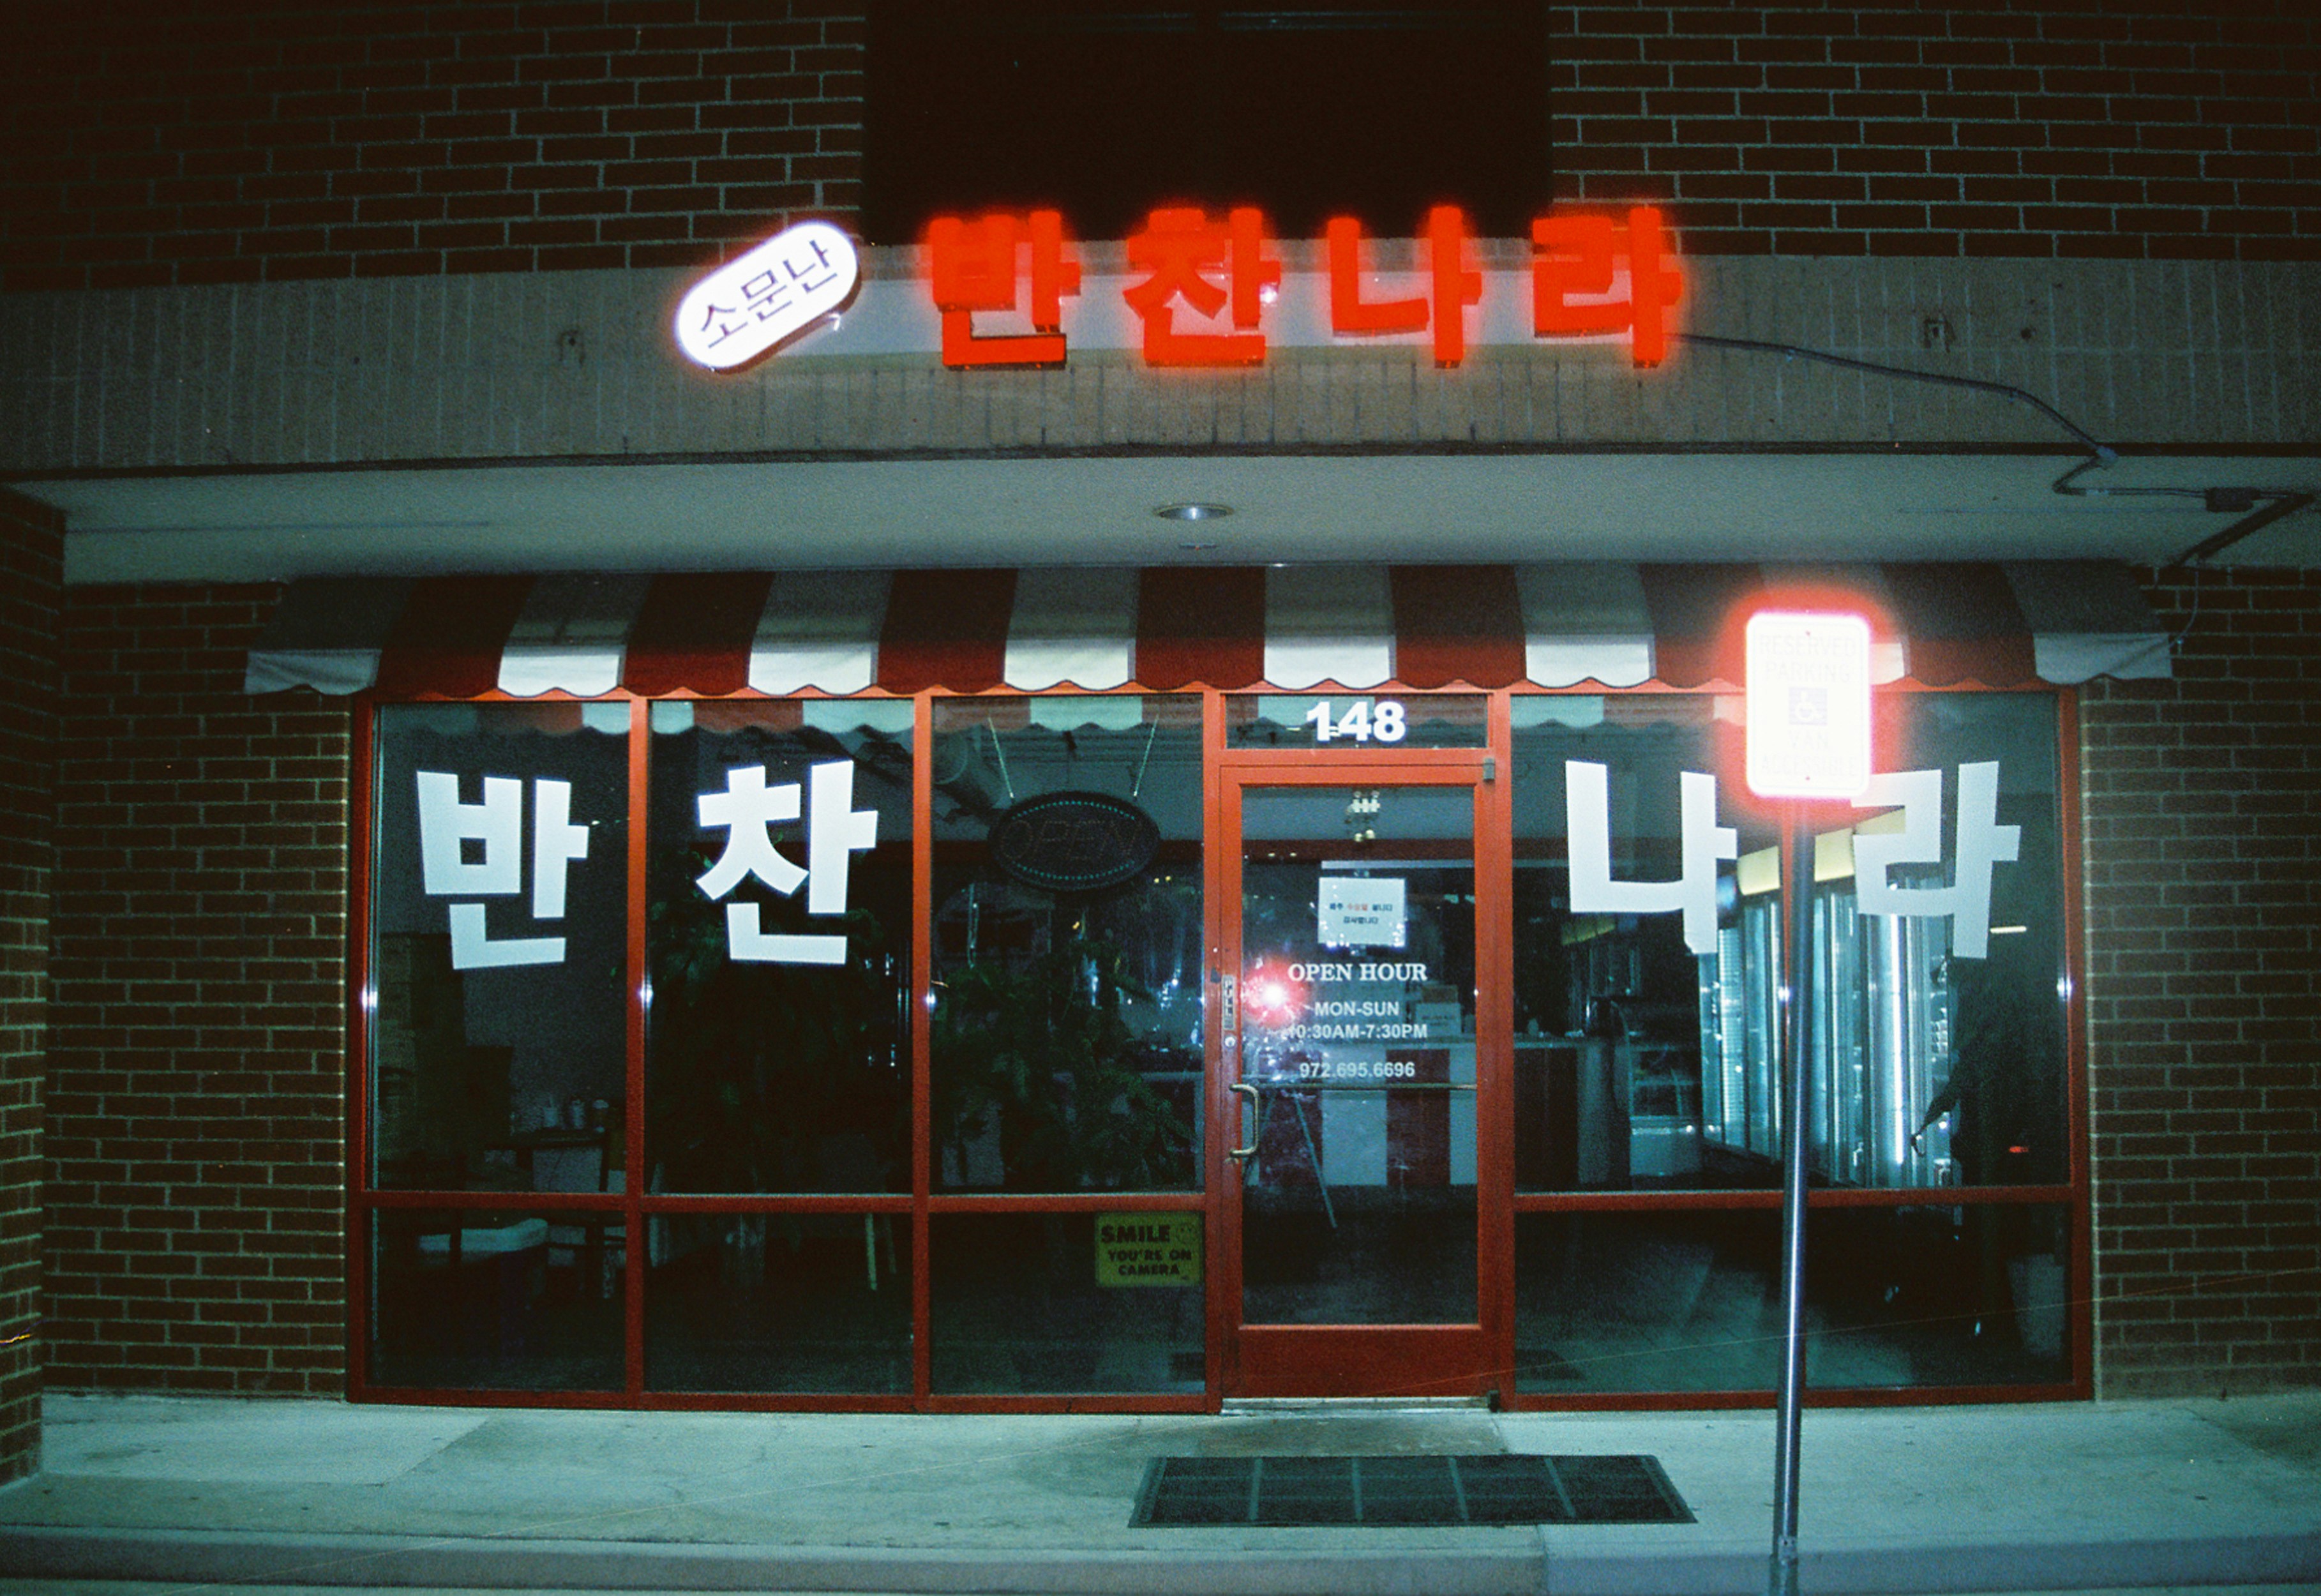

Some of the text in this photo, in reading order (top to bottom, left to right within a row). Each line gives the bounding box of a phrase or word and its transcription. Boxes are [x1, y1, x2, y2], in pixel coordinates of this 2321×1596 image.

[700, 239, 838, 349] 소문난
[929, 206, 1683, 370] 반찬나라
[1759, 635, 1856, 657] RESERVED
[1762, 661, 1851, 682] PARKING
[1306, 701, 1406, 742] 148
[1789, 730, 1829, 751] VAN
[1288, 963, 1428, 981] OPEN HOUR
[1314, 1001, 1399, 1016] MON-SUN
[1298, 1062, 1416, 1078] 972.695.6696
[1100, 1224, 1170, 1243] SMILE
[1169, 1249, 1192, 1261] ON
[1118, 1264, 1180, 1276] CAMERA
